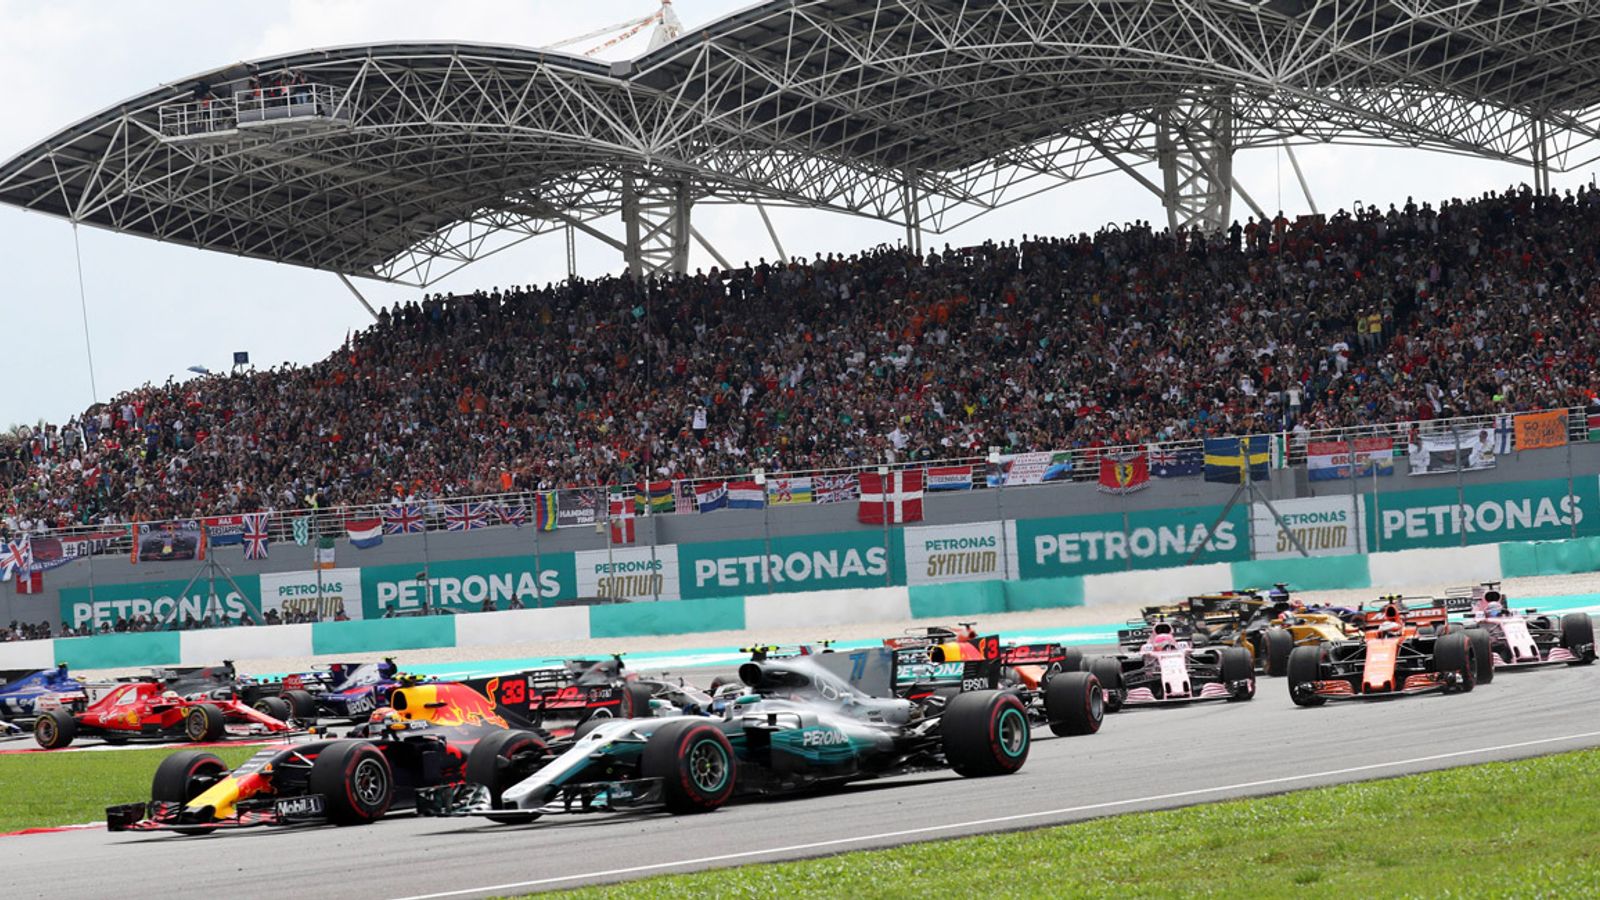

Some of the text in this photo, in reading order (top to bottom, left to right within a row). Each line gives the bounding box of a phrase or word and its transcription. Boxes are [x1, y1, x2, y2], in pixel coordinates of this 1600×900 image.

[218, 517, 232, 525] MAX
[560, 508, 594, 518] HAMMER
[577, 516, 594, 524] TIME
[1383, 495, 1583, 539] PETRONAS
[925, 536, 996, 551] PETRONAS
[1035, 521, 1237, 565] PETRONAS
[595, 559, 662, 573] PETRONAS
[696, 547, 887, 587] PETRONAS
[927, 550, 996, 577] SYNTIUM
[279, 582, 343, 597] PETRONAS
[377, 570, 560, 609] PETRONAS
[73, 592, 246, 628] PETRONAS
[502, 680, 525, 704] 33
[963, 679, 989, 691] EPSON
[278, 799, 306, 816] Mobil
